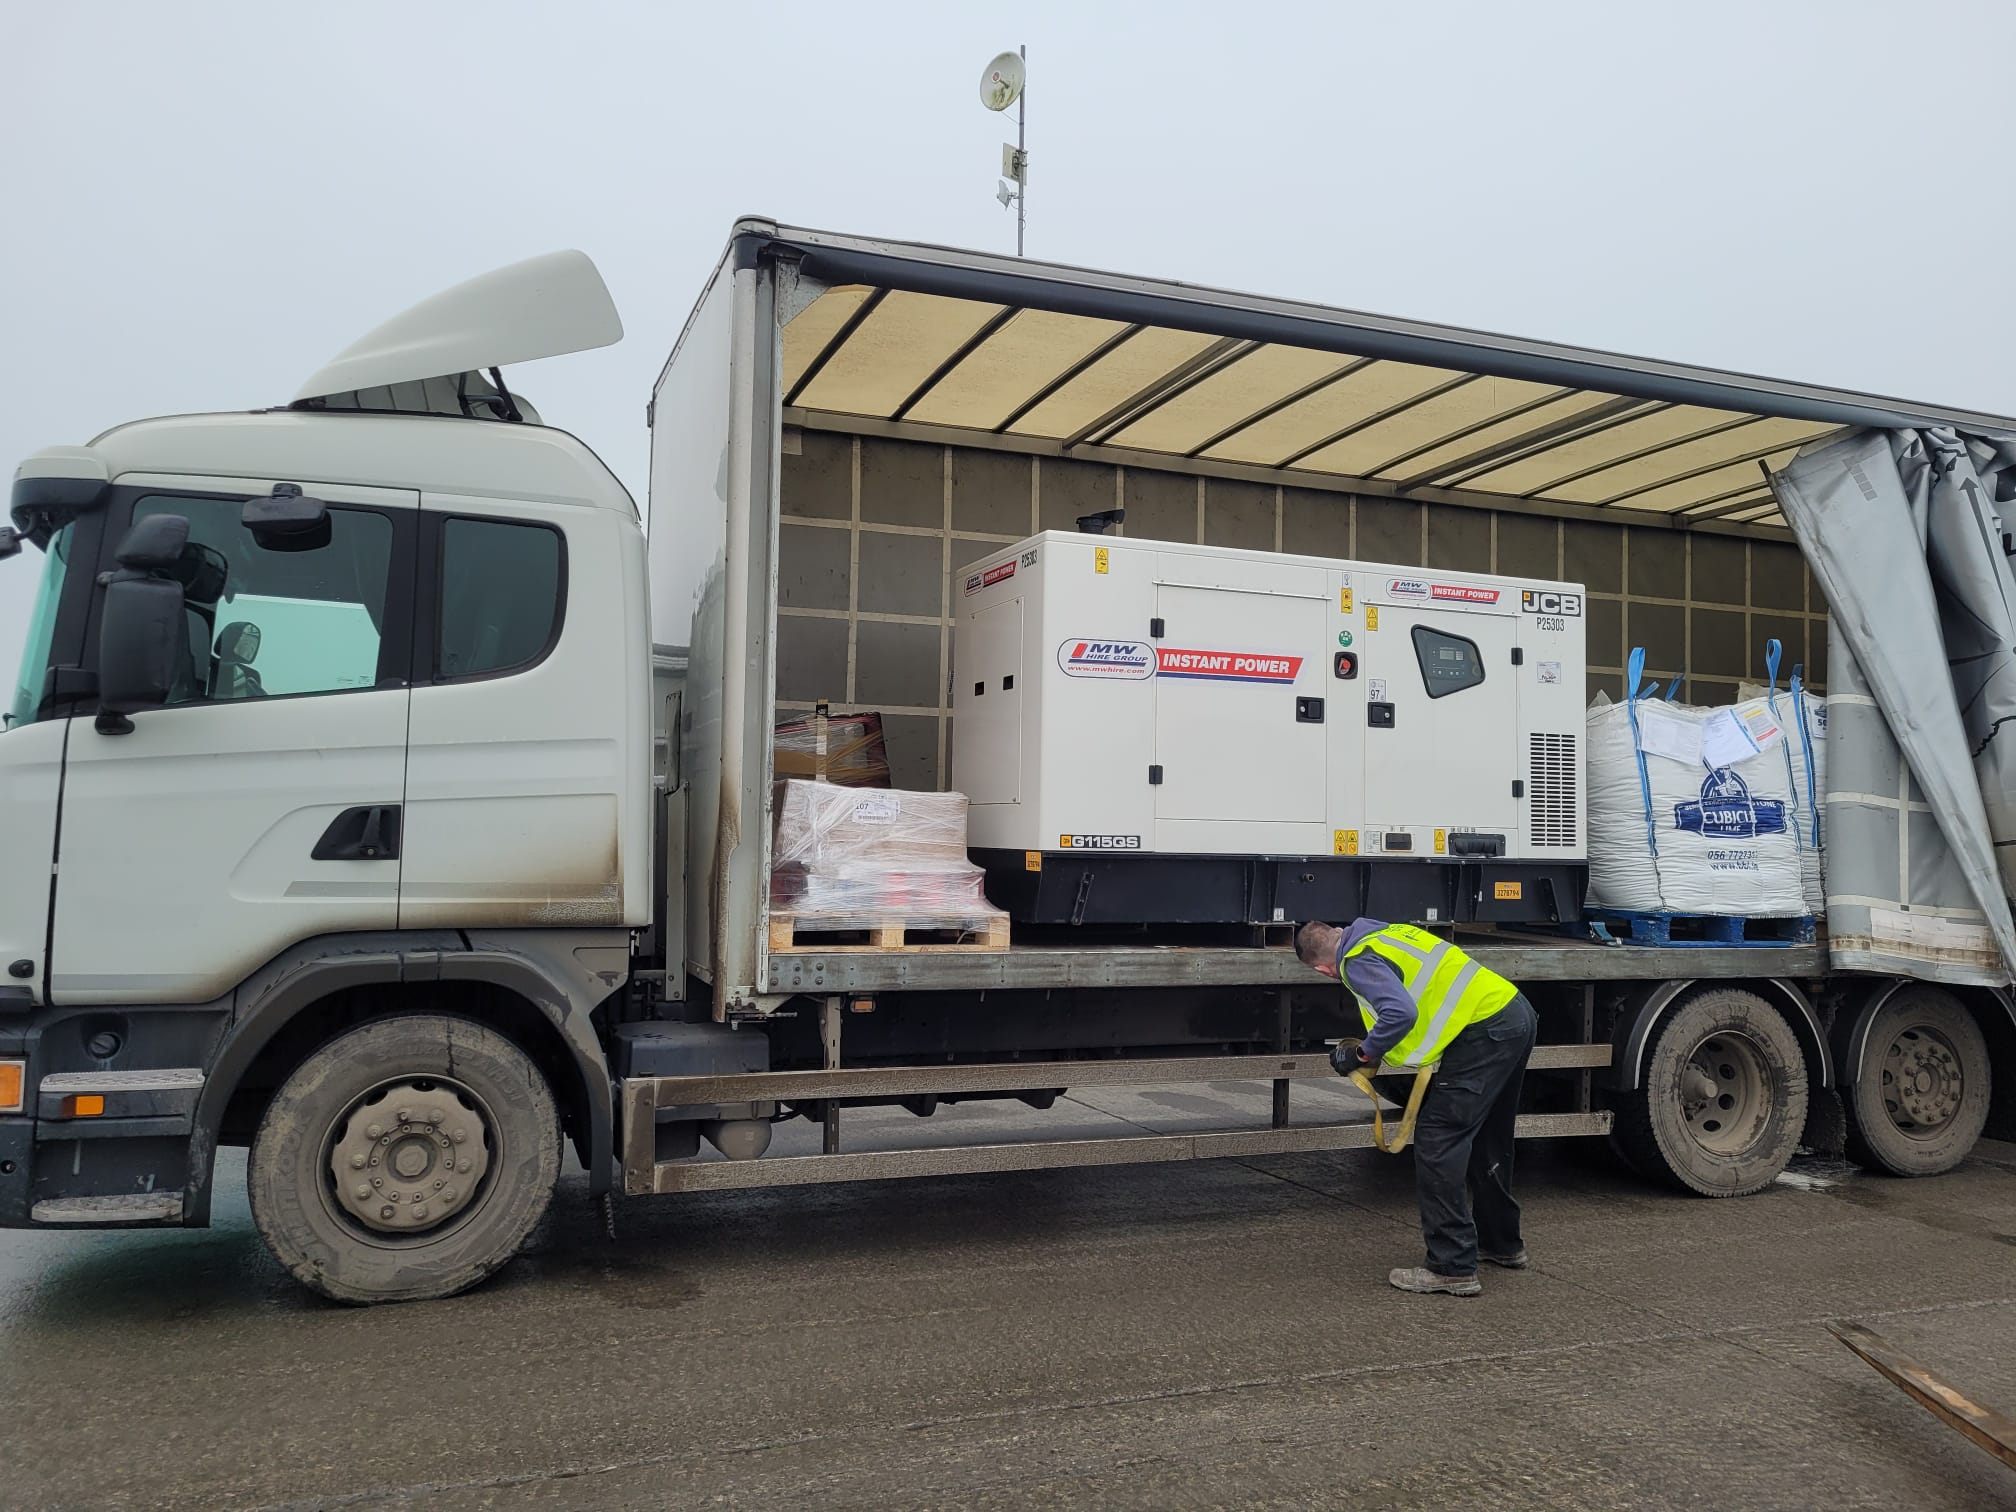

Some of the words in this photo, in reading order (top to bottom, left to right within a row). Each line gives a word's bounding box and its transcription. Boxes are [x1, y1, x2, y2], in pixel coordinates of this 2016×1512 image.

[1434, 587, 1466, 597] INSTANT
[1467, 590, 1494, 600] POWER
[1523, 591, 1580, 616] JCB
[1536, 617, 1565, 632] P25303
[1089, 643, 1138, 655] MW
[1113, 655, 1149, 663] GROUP
[1163, 653, 1232, 670] INSTANT
[1234, 658, 1290, 674] POWER
[1067, 666, 1145, 674] www.mwhire.com
[1370, 688, 1380, 700] 97
[1707, 850, 1726, 860] 056
